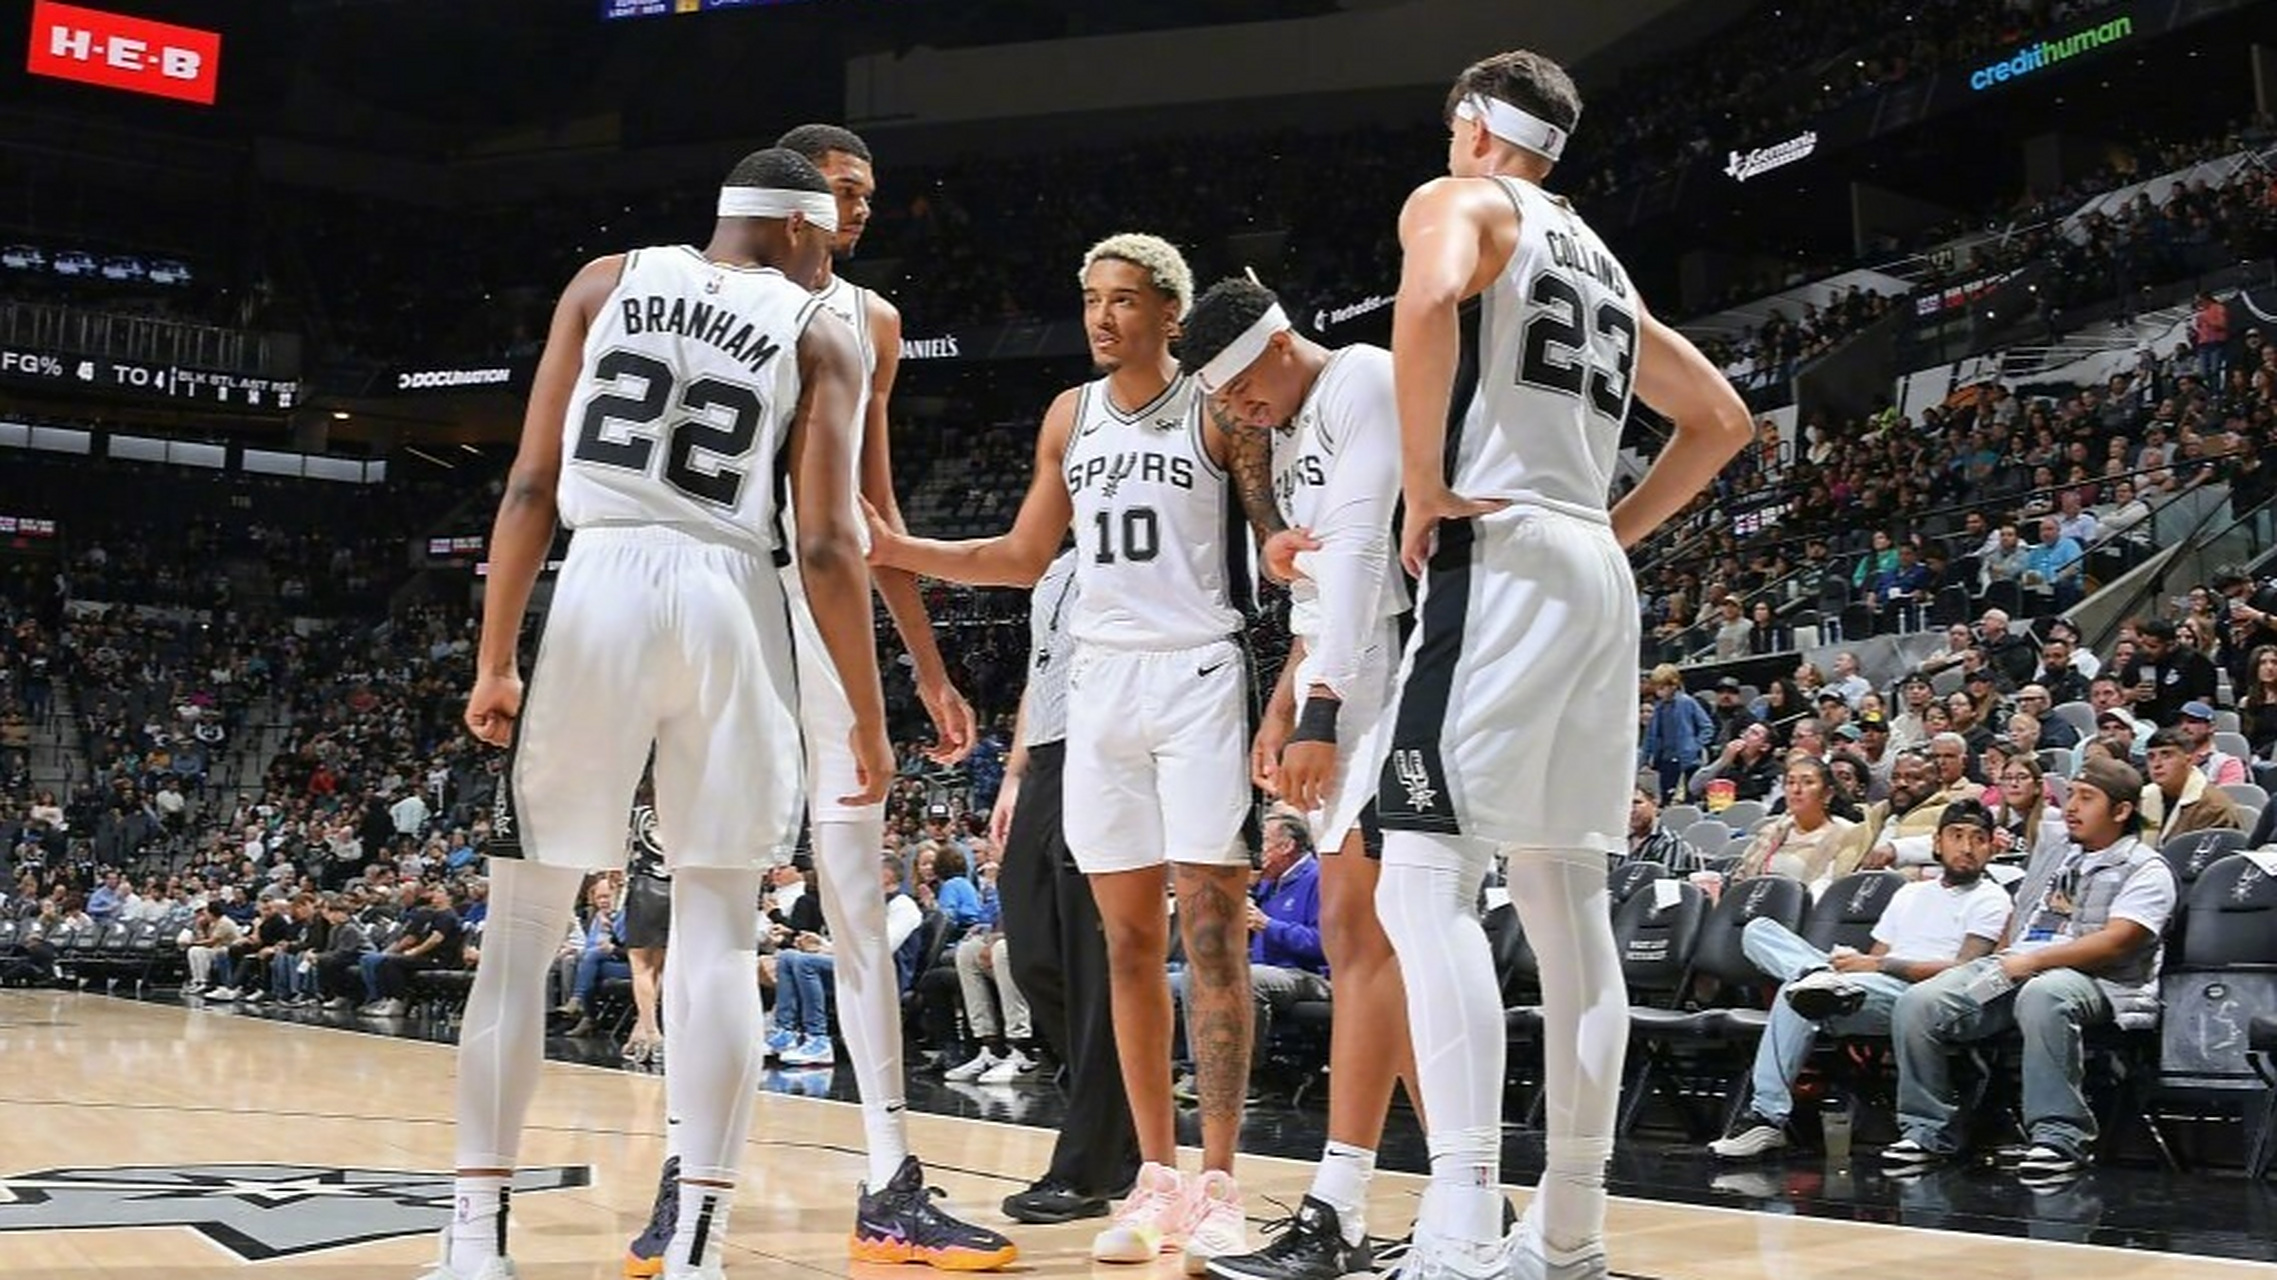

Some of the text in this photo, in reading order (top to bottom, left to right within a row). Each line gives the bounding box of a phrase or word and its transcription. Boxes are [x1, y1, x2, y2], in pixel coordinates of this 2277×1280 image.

[1971, 17, 2132, 90] credithuman
[1750, 130, 1818, 163] Germania
[1546, 230, 1626, 298] COLLINS
[622, 296, 780, 373] BRANHAM
[1515, 268, 1637, 427] 23
[1, 352, 63, 377] FG%
[112, 363, 149, 386] TO
[240, 378, 268, 391] AST
[571, 347, 766, 507] 22
[1068, 452, 1193, 498] SPURS
[1095, 507, 1160, 565] 10
